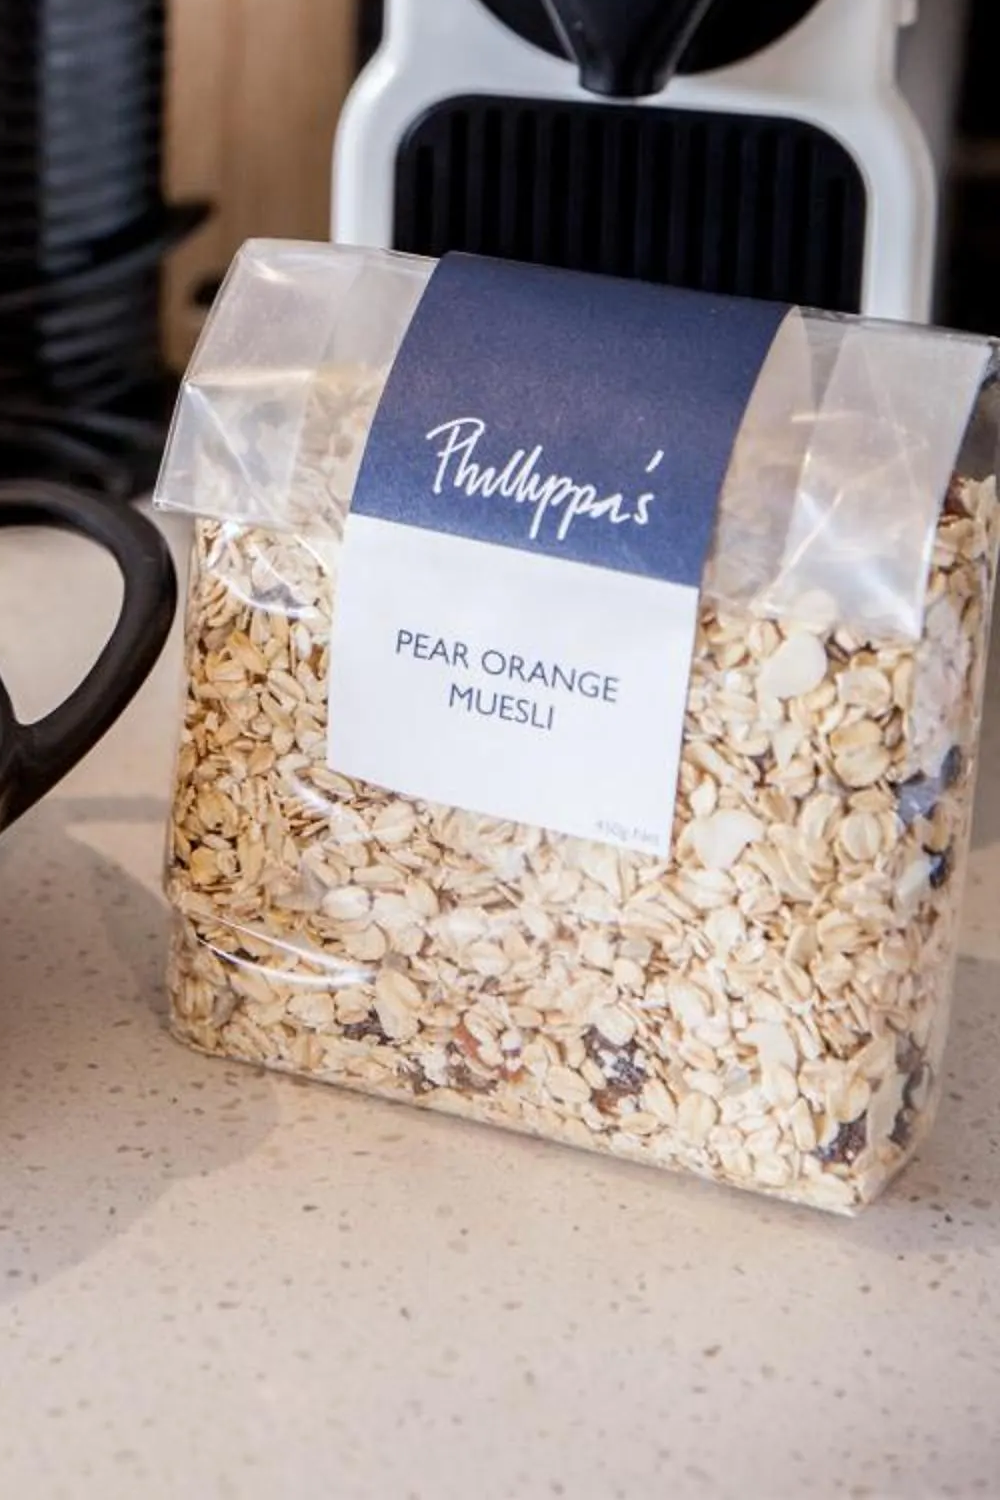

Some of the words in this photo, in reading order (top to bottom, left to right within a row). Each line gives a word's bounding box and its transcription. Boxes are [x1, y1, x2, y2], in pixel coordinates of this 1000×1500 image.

[396, 629, 469, 669] PEAR
[481, 649, 620, 703] ORANGE
[449, 683, 554, 731] MUESLI
